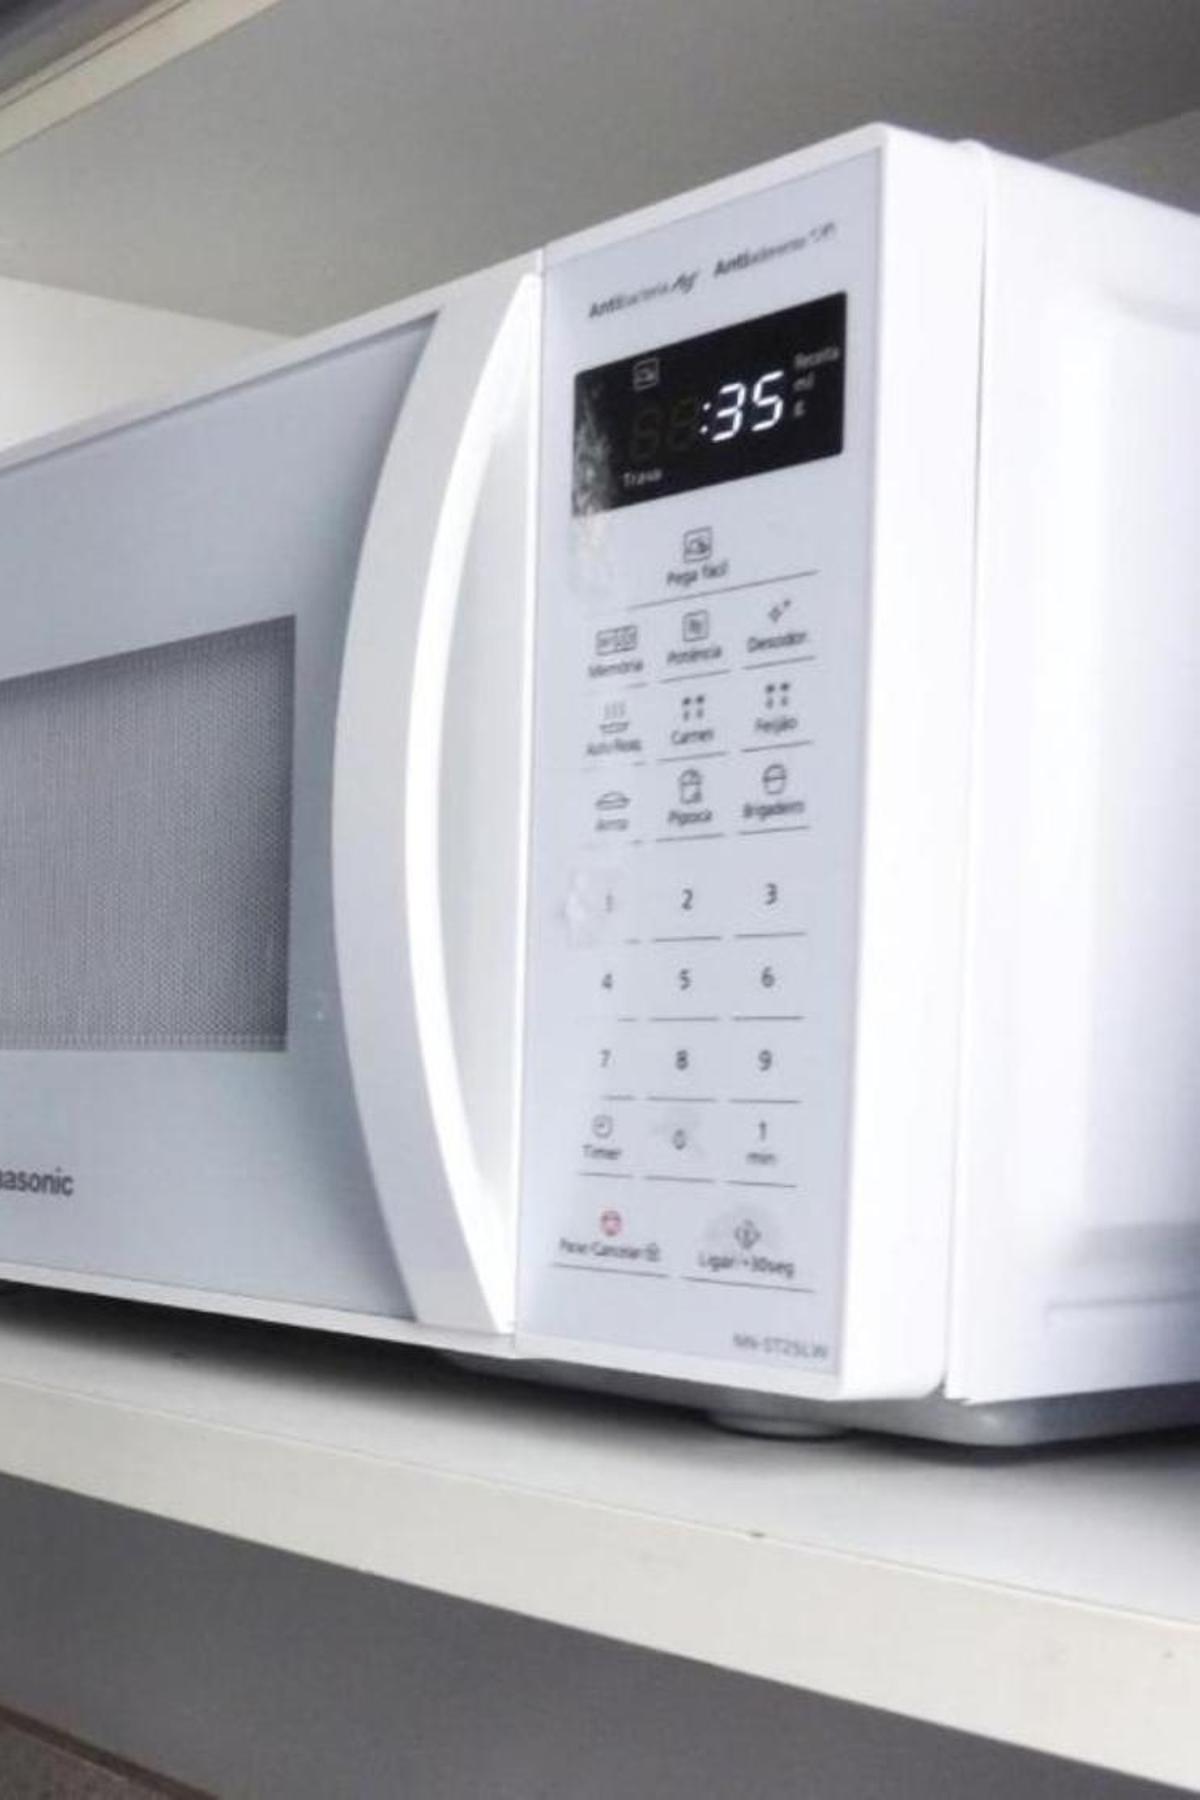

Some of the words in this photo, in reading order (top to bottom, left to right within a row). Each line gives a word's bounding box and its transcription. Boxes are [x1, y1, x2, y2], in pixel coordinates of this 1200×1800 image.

[681, 888, 694, 911] 2
[764, 882, 778, 906] 3
[601, 972, 614, 991] 4
[678, 968, 692, 990] 5
[760, 965, 776, 989] 6
[599, 1049, 612, 1069] 7
[675, 1049, 689, 1071] 8
[757, 1049, 773, 1072] 9
[672, 1128, 687, 1151] 0
[758, 1120, 768, 1142] 1
